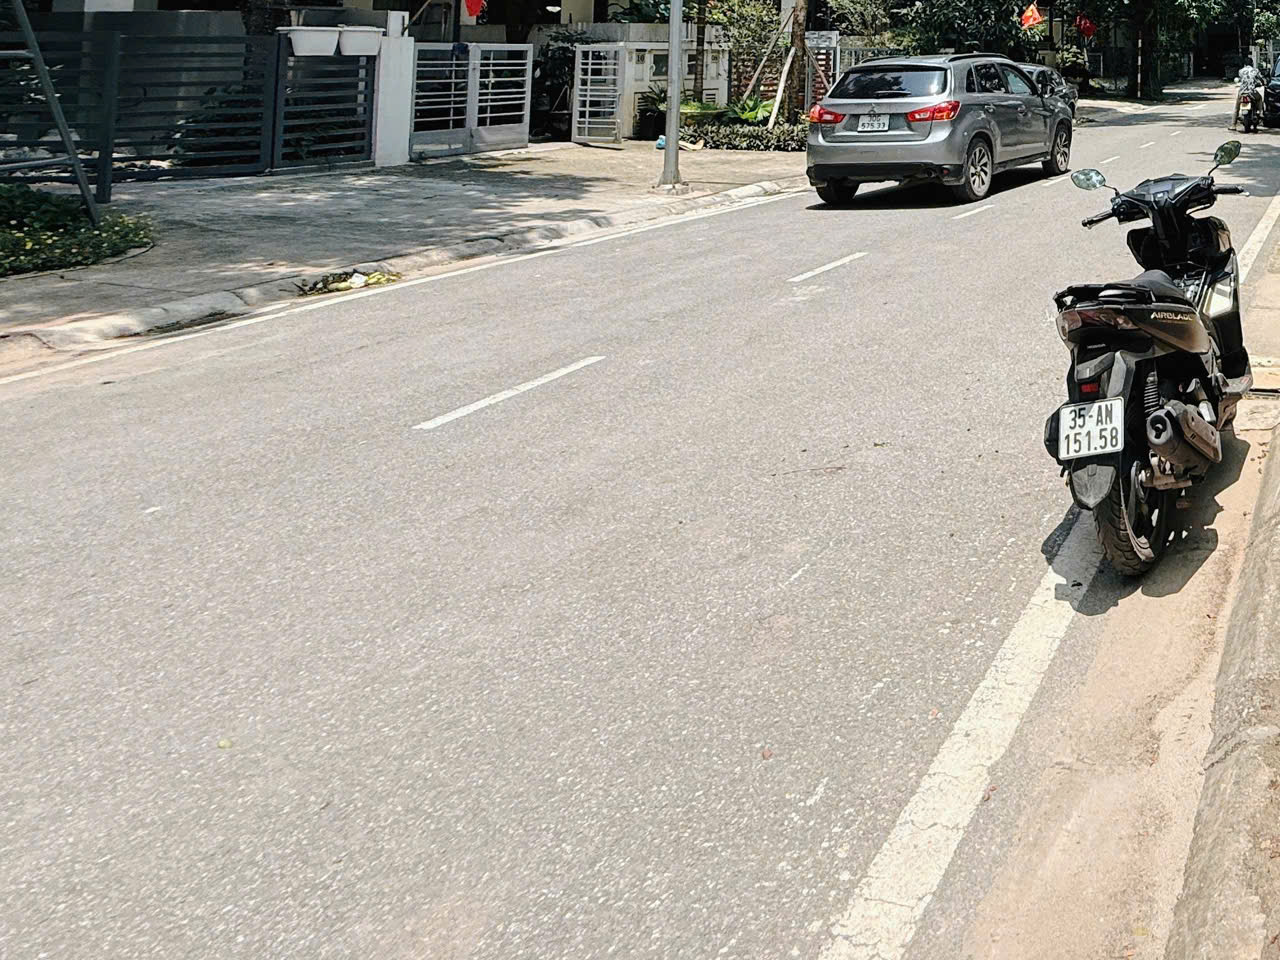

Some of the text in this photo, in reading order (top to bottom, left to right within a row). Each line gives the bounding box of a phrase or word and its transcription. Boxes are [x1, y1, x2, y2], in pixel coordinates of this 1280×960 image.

[861, 122, 886, 130] 57533
[1068, 403, 1113, 430] 35-AN
[1064, 426, 1119, 456] 151.58
